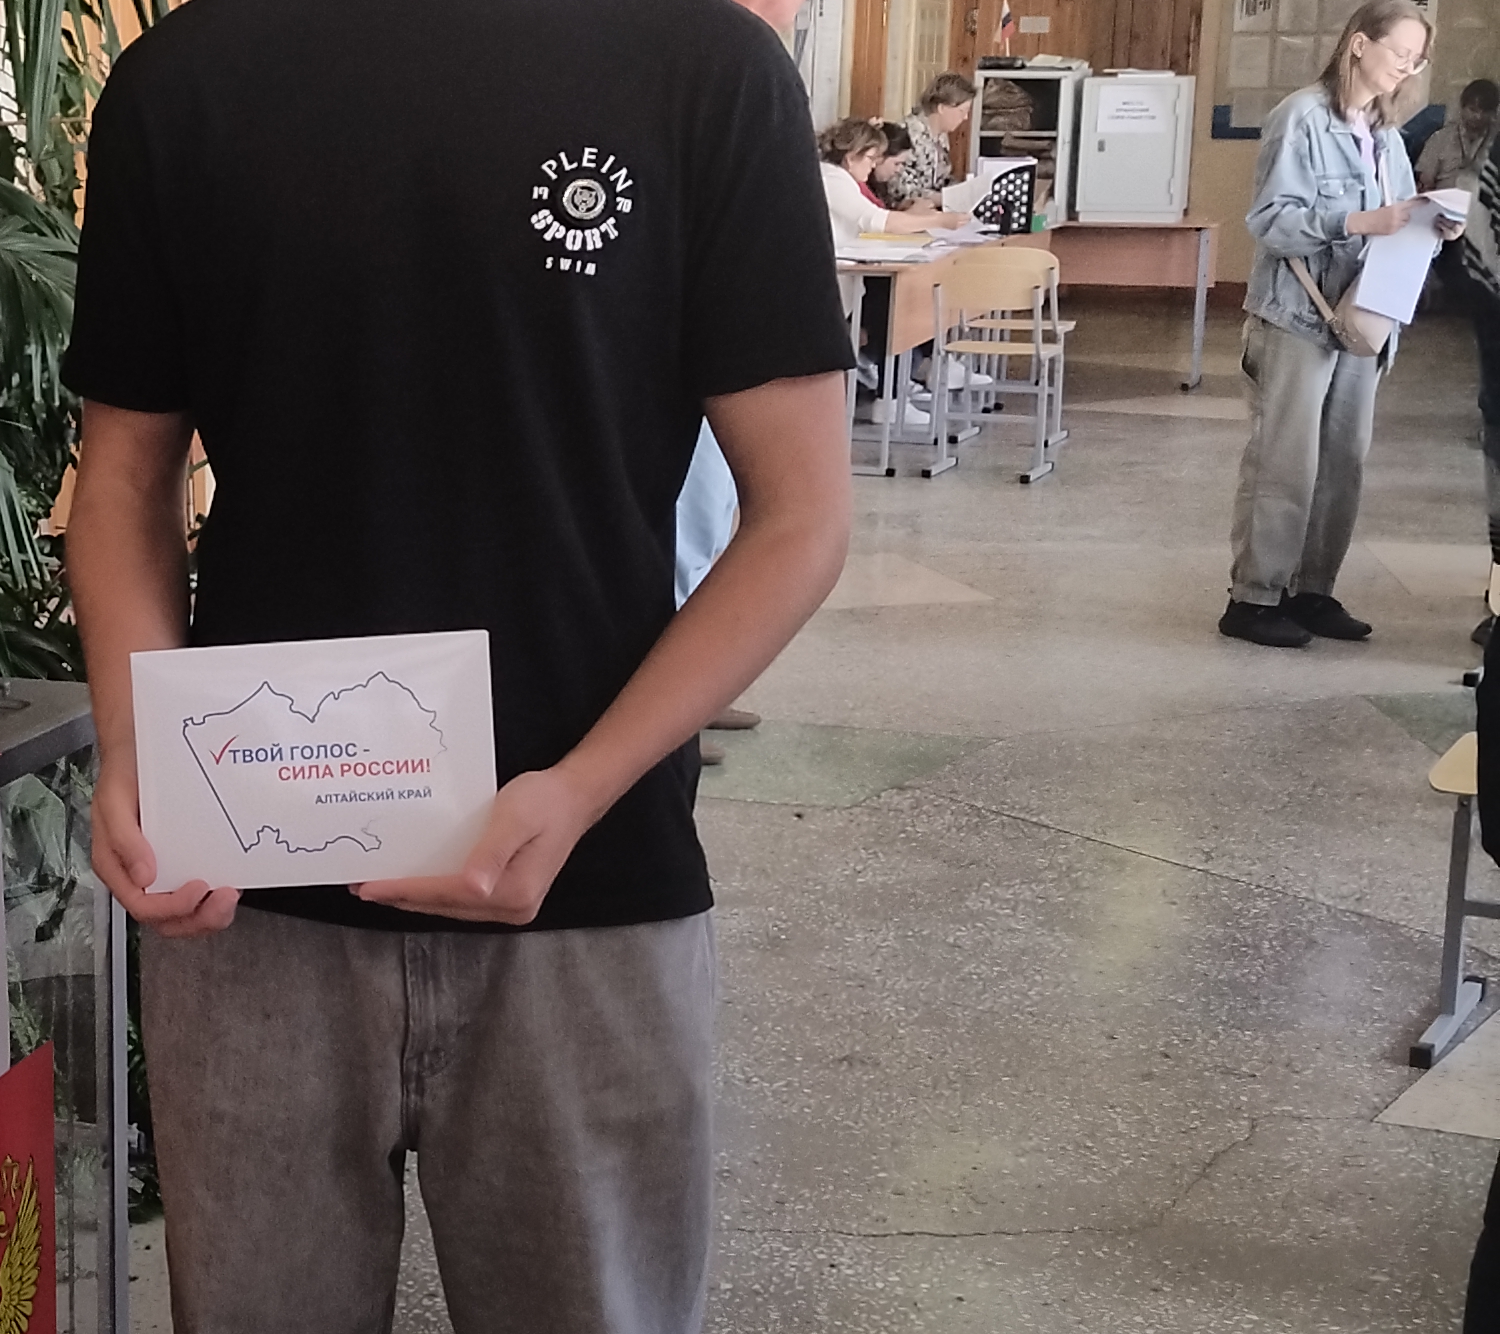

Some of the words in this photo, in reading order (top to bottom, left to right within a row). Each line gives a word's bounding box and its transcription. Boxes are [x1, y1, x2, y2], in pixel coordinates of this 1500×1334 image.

[541, 147, 634, 193] PLEIN
[530, 208, 619, 251] SPORT
[545, 257, 596, 276] SWIM
[229, 743, 283, 764] ТВОЙ
[290, 742, 357, 762] ГОЛОС
[277, 764, 334, 781] СИЛА
[339, 758, 431, 778] РОССИИ!
[315, 787, 395, 805] АЛТАЙСКИЙ
[398, 785, 433, 800] КРАЙ
